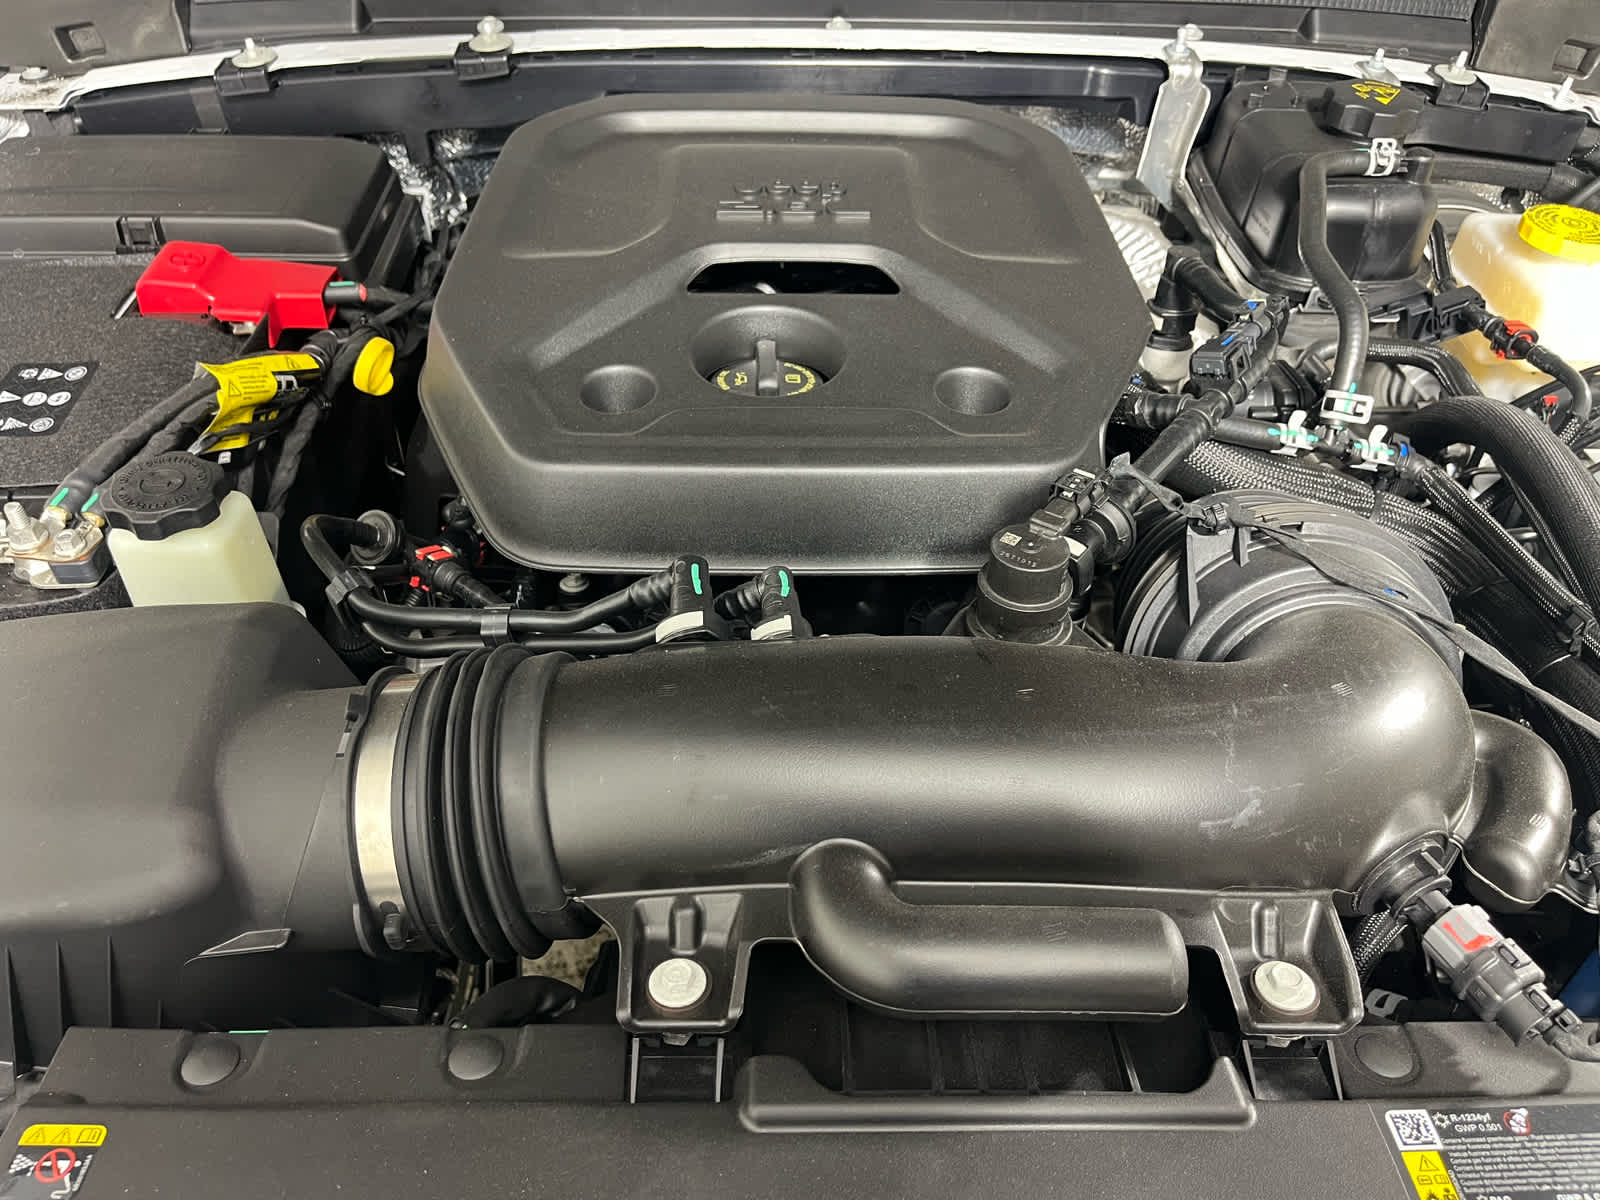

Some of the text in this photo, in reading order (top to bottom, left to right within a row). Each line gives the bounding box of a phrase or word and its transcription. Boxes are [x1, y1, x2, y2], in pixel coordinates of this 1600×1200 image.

[1449, 1112, 1491, 1122] R-1234yf
[1454, 1123, 1503, 1132] GWP 0.501
